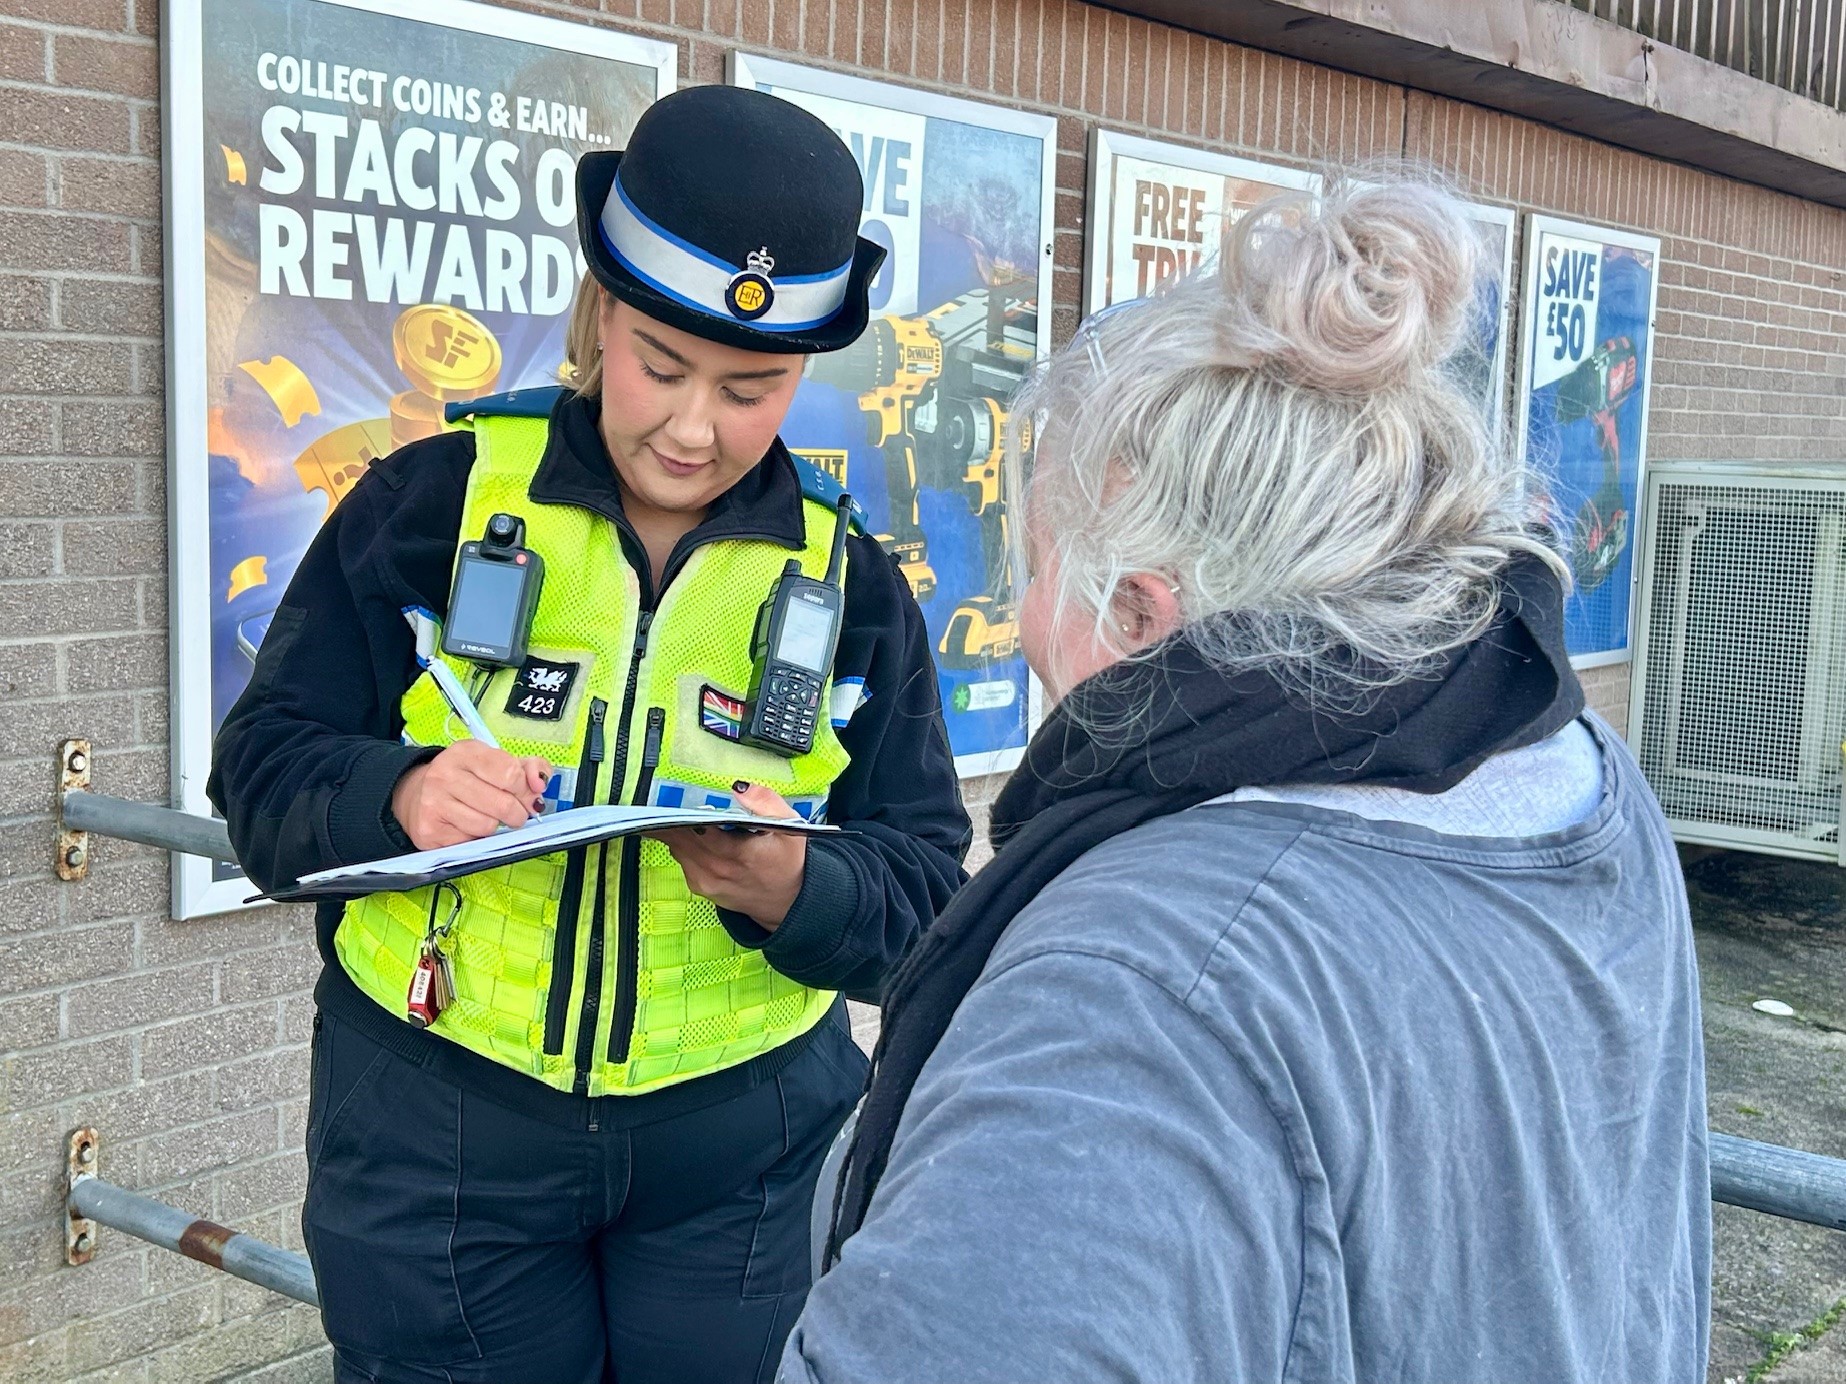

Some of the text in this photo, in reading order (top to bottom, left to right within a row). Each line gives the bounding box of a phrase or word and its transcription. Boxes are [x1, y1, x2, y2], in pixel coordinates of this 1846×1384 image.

[257, 52, 611, 145] COLLECT COINS & EARN...
[259, 105, 521, 221] STACKS
[833, 128, 912, 217] VE
[1134, 179, 1206, 244] FREE
[259, 204, 588, 316] REWARD
[1543, 246, 1597, 301] SAVE
[1546, 302, 1586, 362] £50
[518, 694, 556, 715] 423
